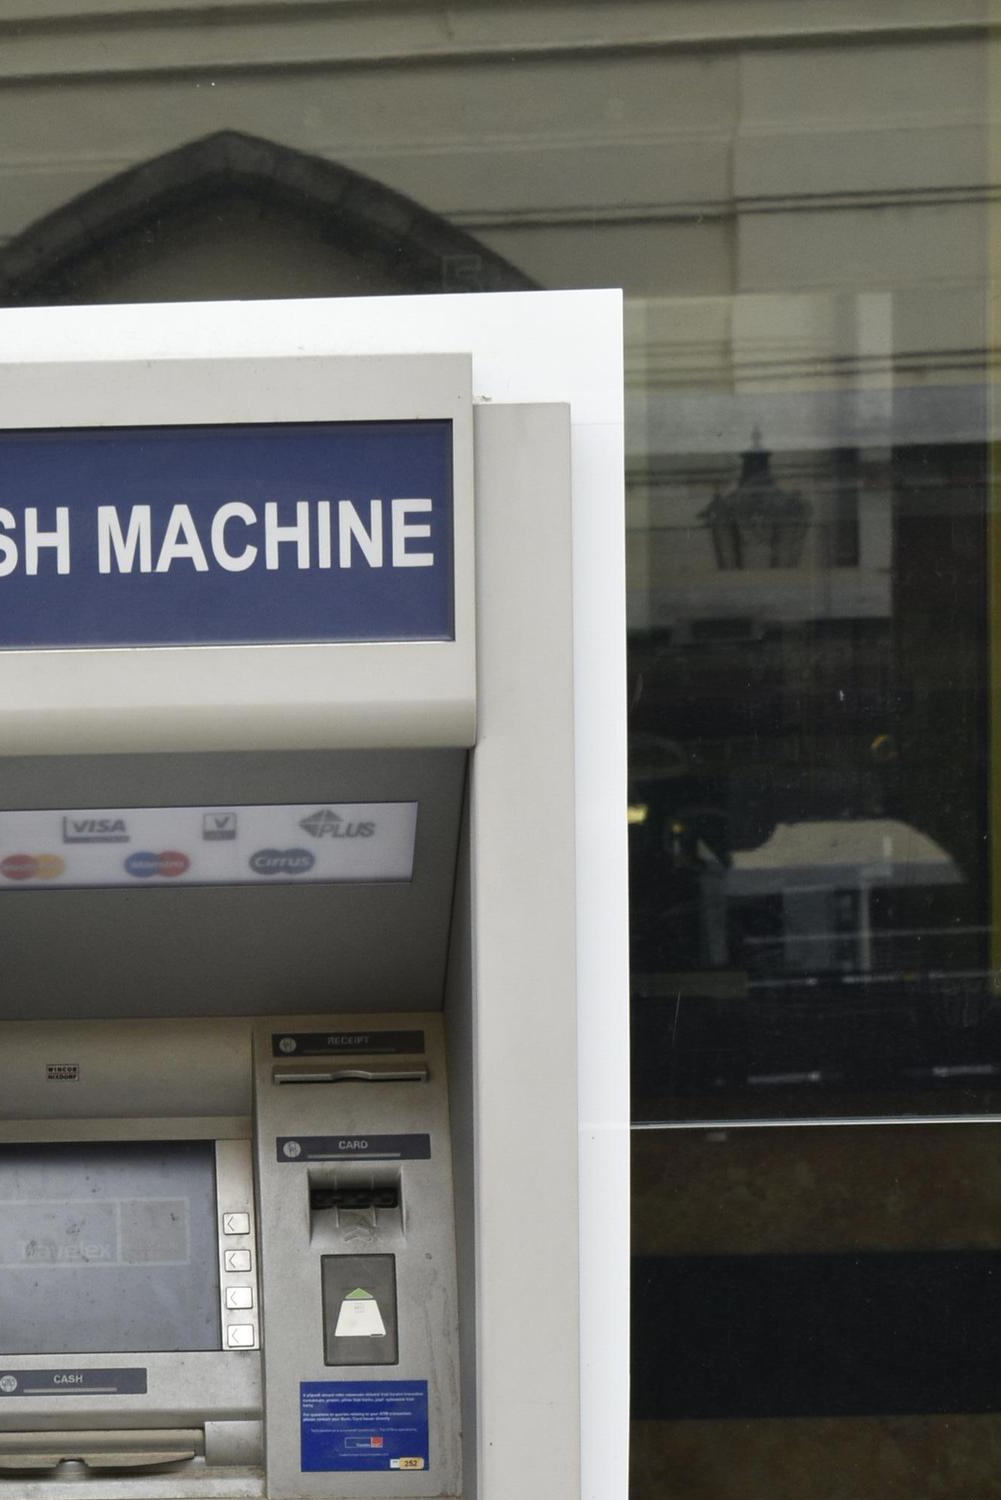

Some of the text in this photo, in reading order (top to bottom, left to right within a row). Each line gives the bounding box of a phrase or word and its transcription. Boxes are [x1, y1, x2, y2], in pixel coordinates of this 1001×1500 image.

[98, 498, 435, 574] MACHINE
[72, 818, 127, 833] VISA
[318, 821, 376, 838] PLUS
[254, 855, 311, 868] Cirrus
[327, 1035, 370, 1045] RECEIPT
[338, 1140, 369, 1150] CARD
[53, 1373, 83, 1384] CASH
